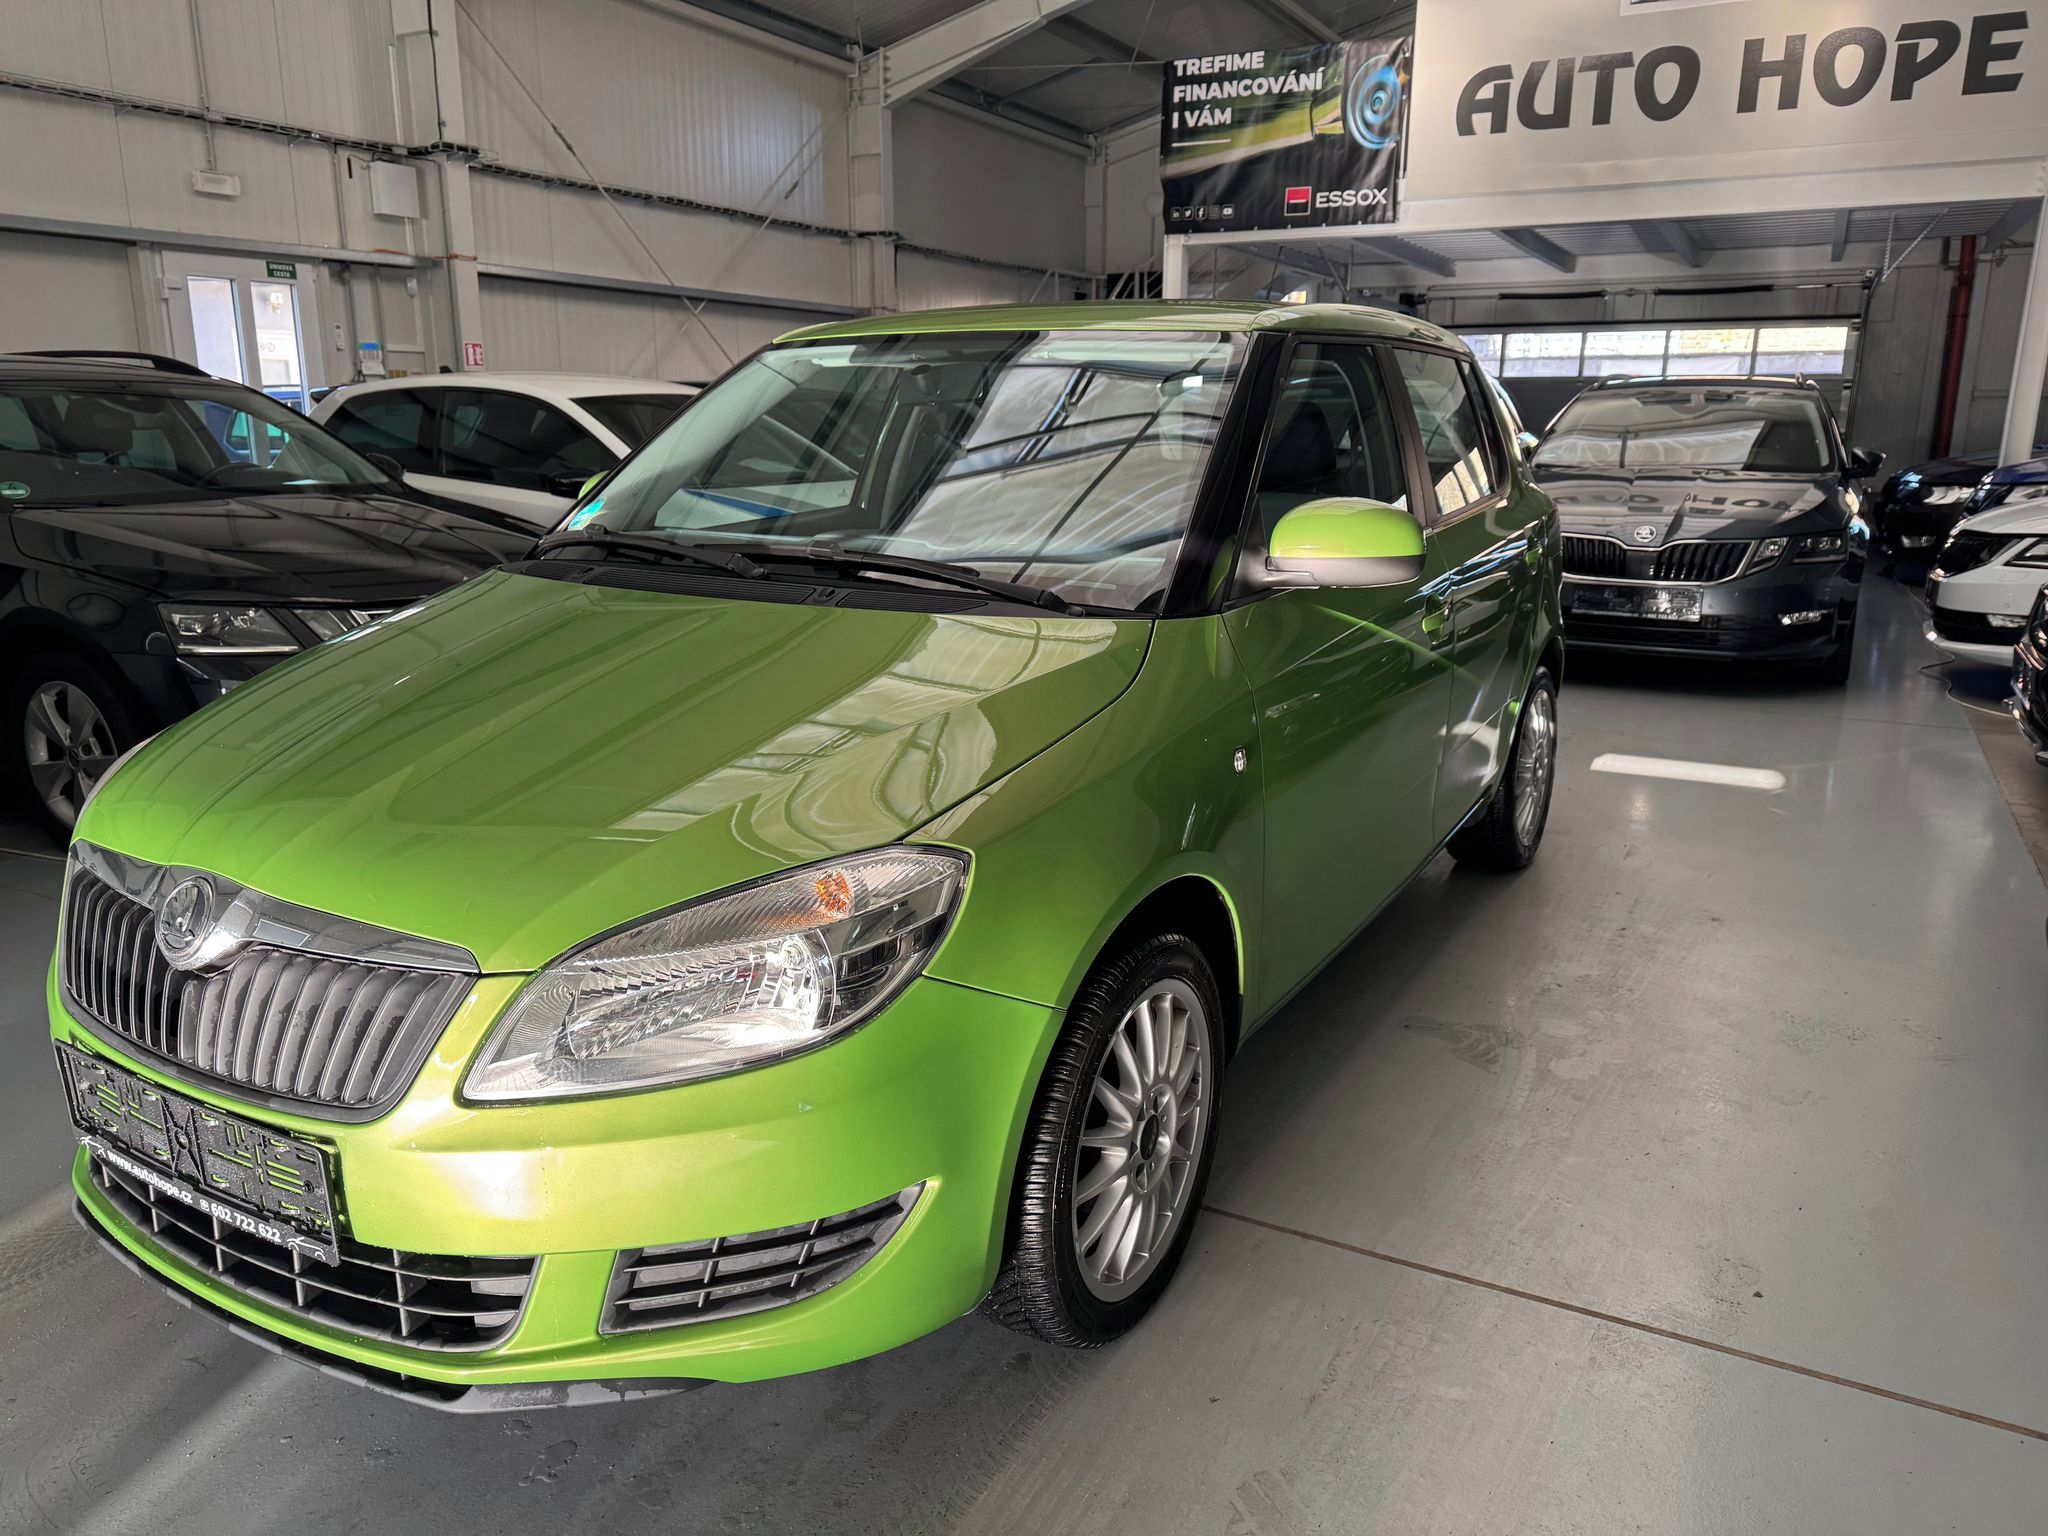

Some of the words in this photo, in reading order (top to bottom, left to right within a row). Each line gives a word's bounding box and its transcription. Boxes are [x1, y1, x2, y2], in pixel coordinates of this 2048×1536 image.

[1173, 51, 1265, 77] TREFIME
[1456, 45, 1701, 136] AUTO
[1736, 10, 2029, 115] HOPE
[1173, 67, 1324, 103] FINANCOVÁNÍ
[1172, 111, 1179, 129] I
[1184, 105, 1232, 128] VÁM
[1315, 187, 1388, 209] ESSOX
[107, 1150, 193, 1204] www.autohope.cz
[211, 1203, 232, 1223] 602
[233, 1212, 256, 1233] 722
[258, 1223, 281, 1243] 622
